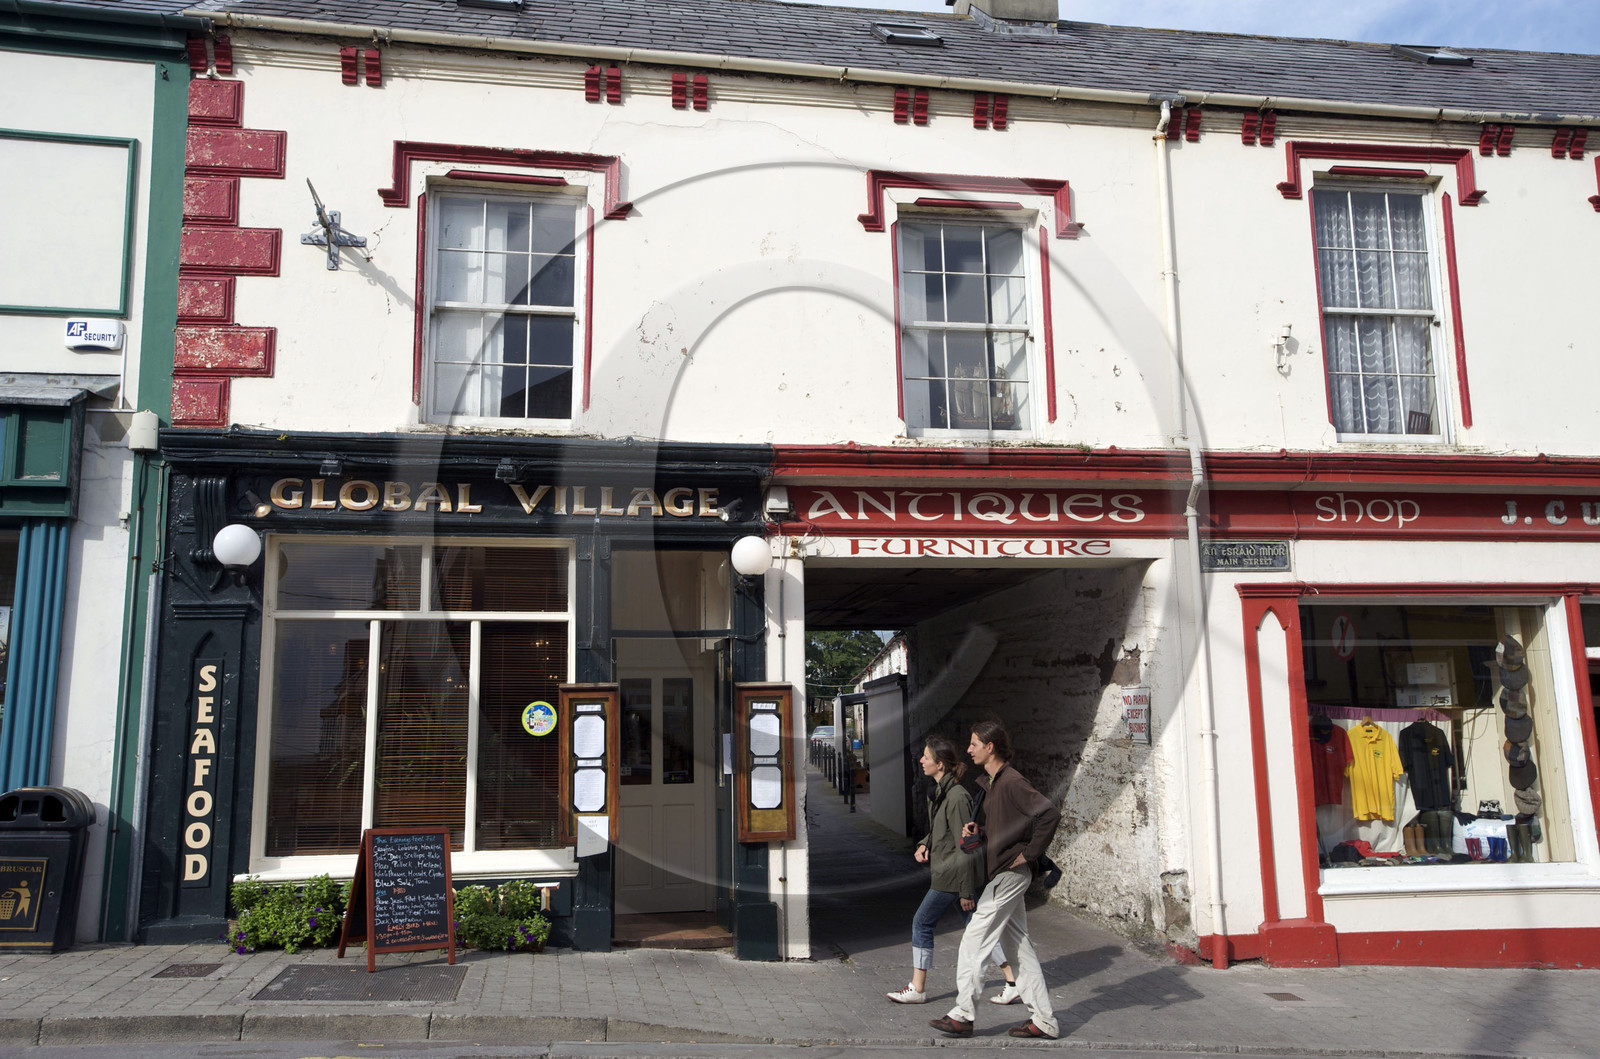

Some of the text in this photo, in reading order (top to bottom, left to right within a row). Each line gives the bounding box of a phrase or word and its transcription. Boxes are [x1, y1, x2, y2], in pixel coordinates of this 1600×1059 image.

[68, 322, 85, 336] AF
[84, 333, 116, 341] SECURITY
[270, 477, 719, 517] GLOBAL VILLAGE
[1217, 558, 1273, 566] MAIN STREET
[1122, 695, 1132, 705] NO
[1126, 708, 1143, 719] EXCEPT
[183, 664, 217, 881] SEAFOOD
[0, 865, 42, 873] BRUSCAR
